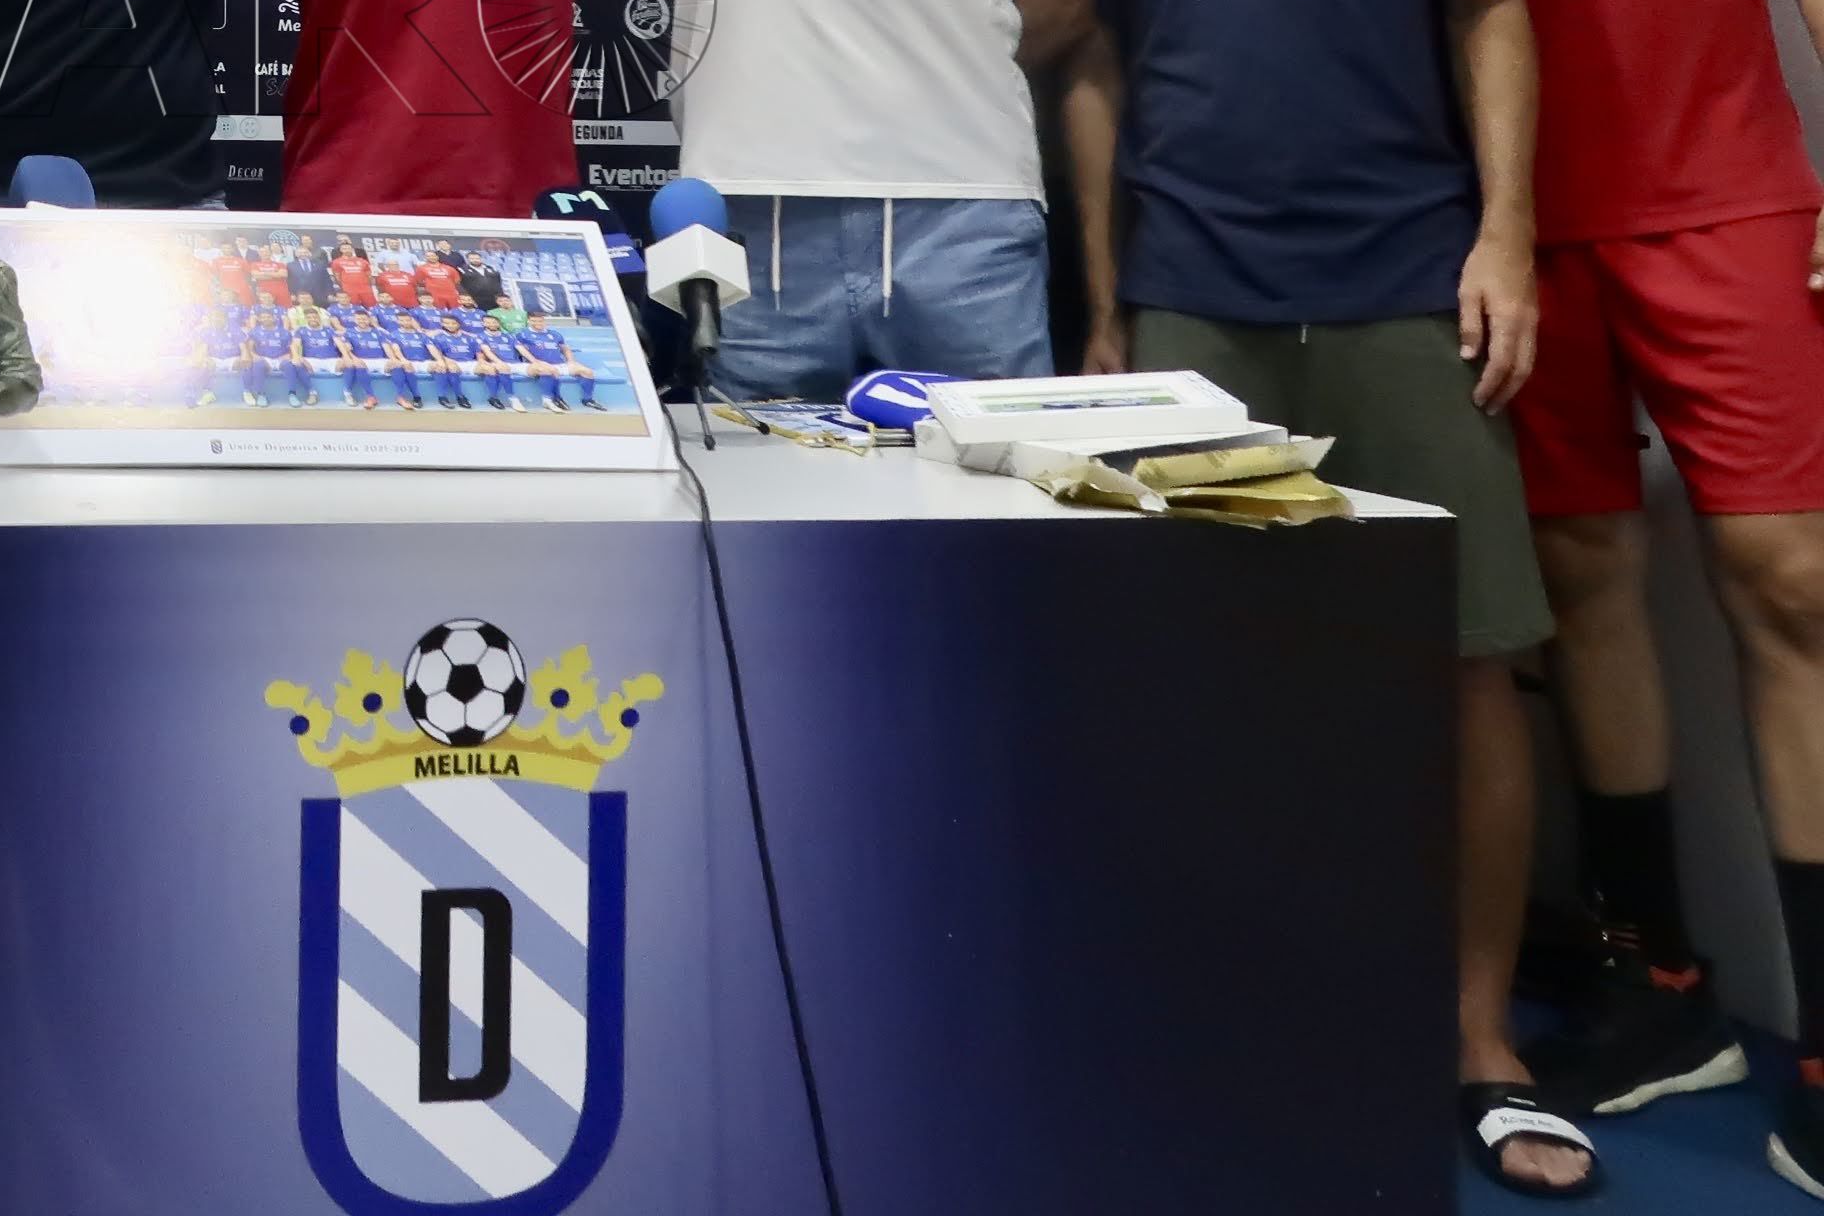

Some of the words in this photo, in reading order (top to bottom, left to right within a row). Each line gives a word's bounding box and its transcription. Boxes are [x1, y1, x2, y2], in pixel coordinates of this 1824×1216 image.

[574, 125, 625, 140] EGUNDA
[588, 163, 680, 185] Eventos
[414, 753, 521, 779] MELILLA
[418, 887, 513, 1104] D
